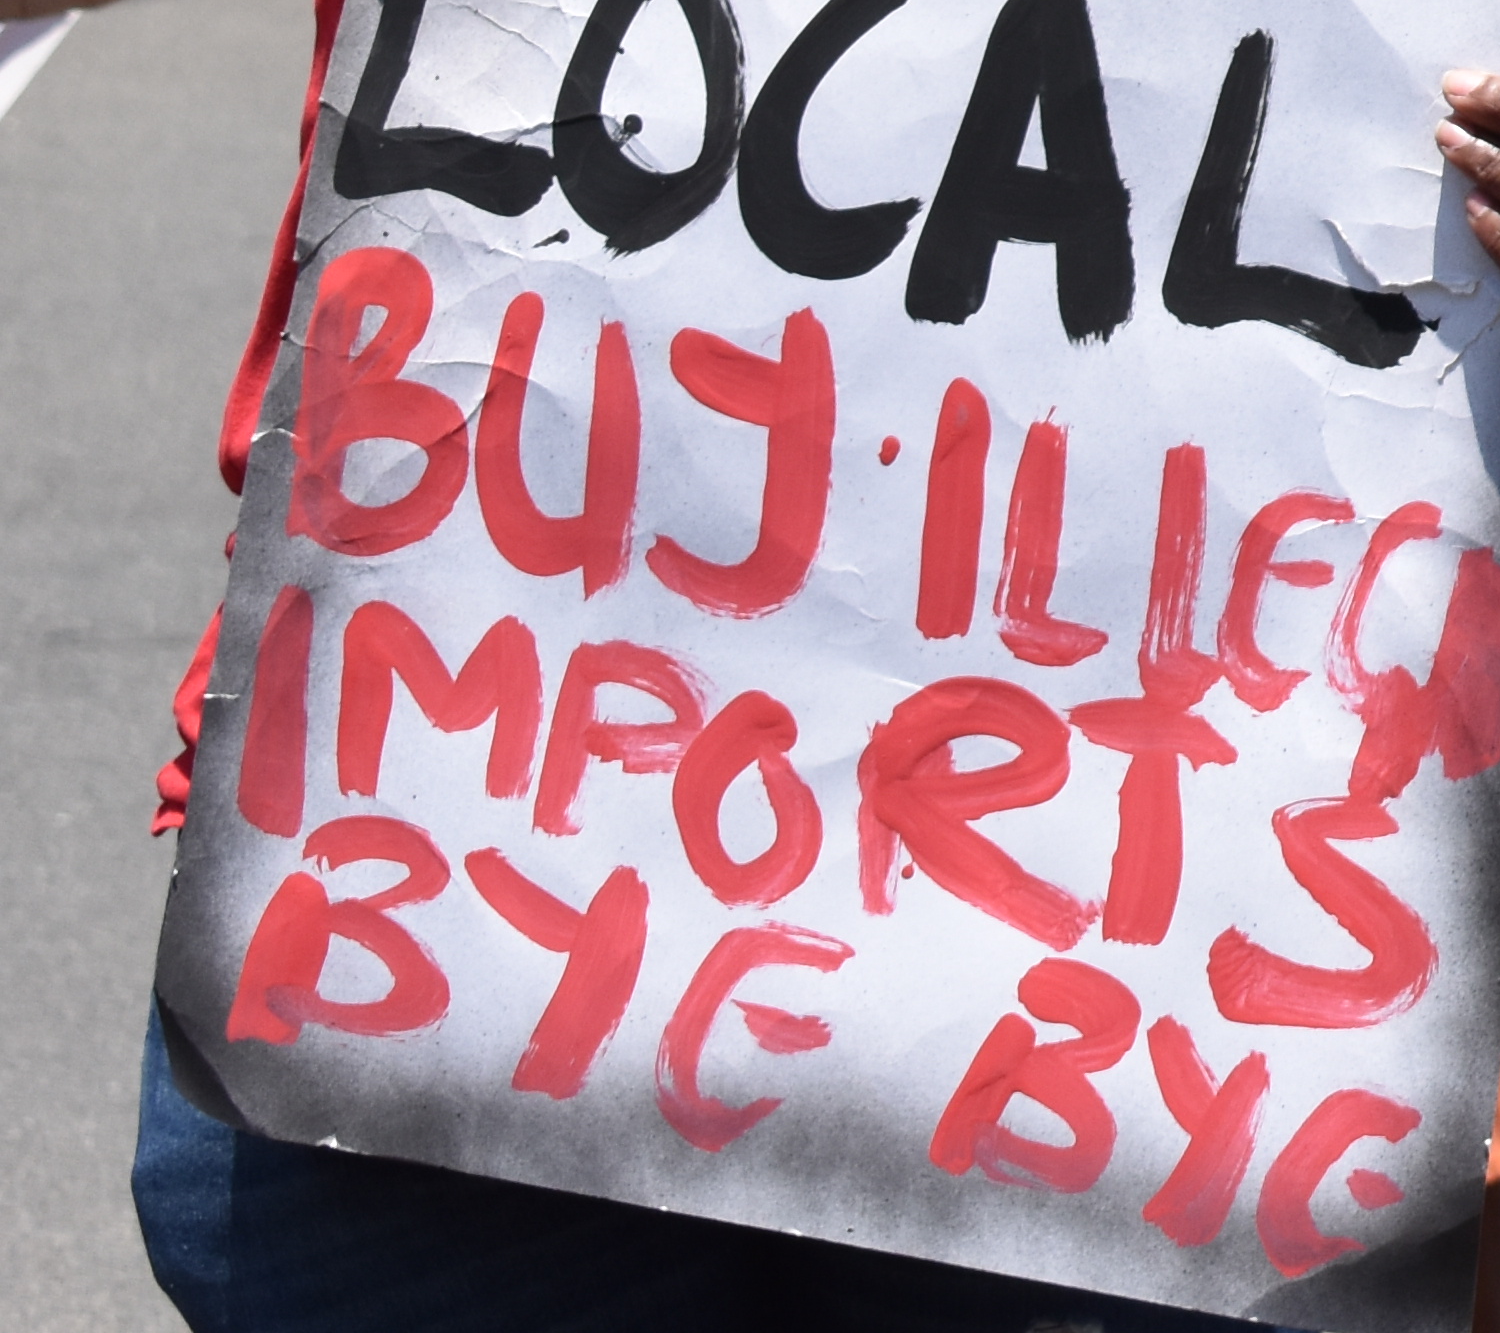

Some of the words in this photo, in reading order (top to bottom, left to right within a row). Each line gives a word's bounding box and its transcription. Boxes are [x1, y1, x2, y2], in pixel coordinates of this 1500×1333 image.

[286, 247, 836, 620] BUY
[238, 581, 1438, 1027] IMPORTS
[225, 813, 858, 1155] BYE
[927, 955, 1423, 1279] BYE
